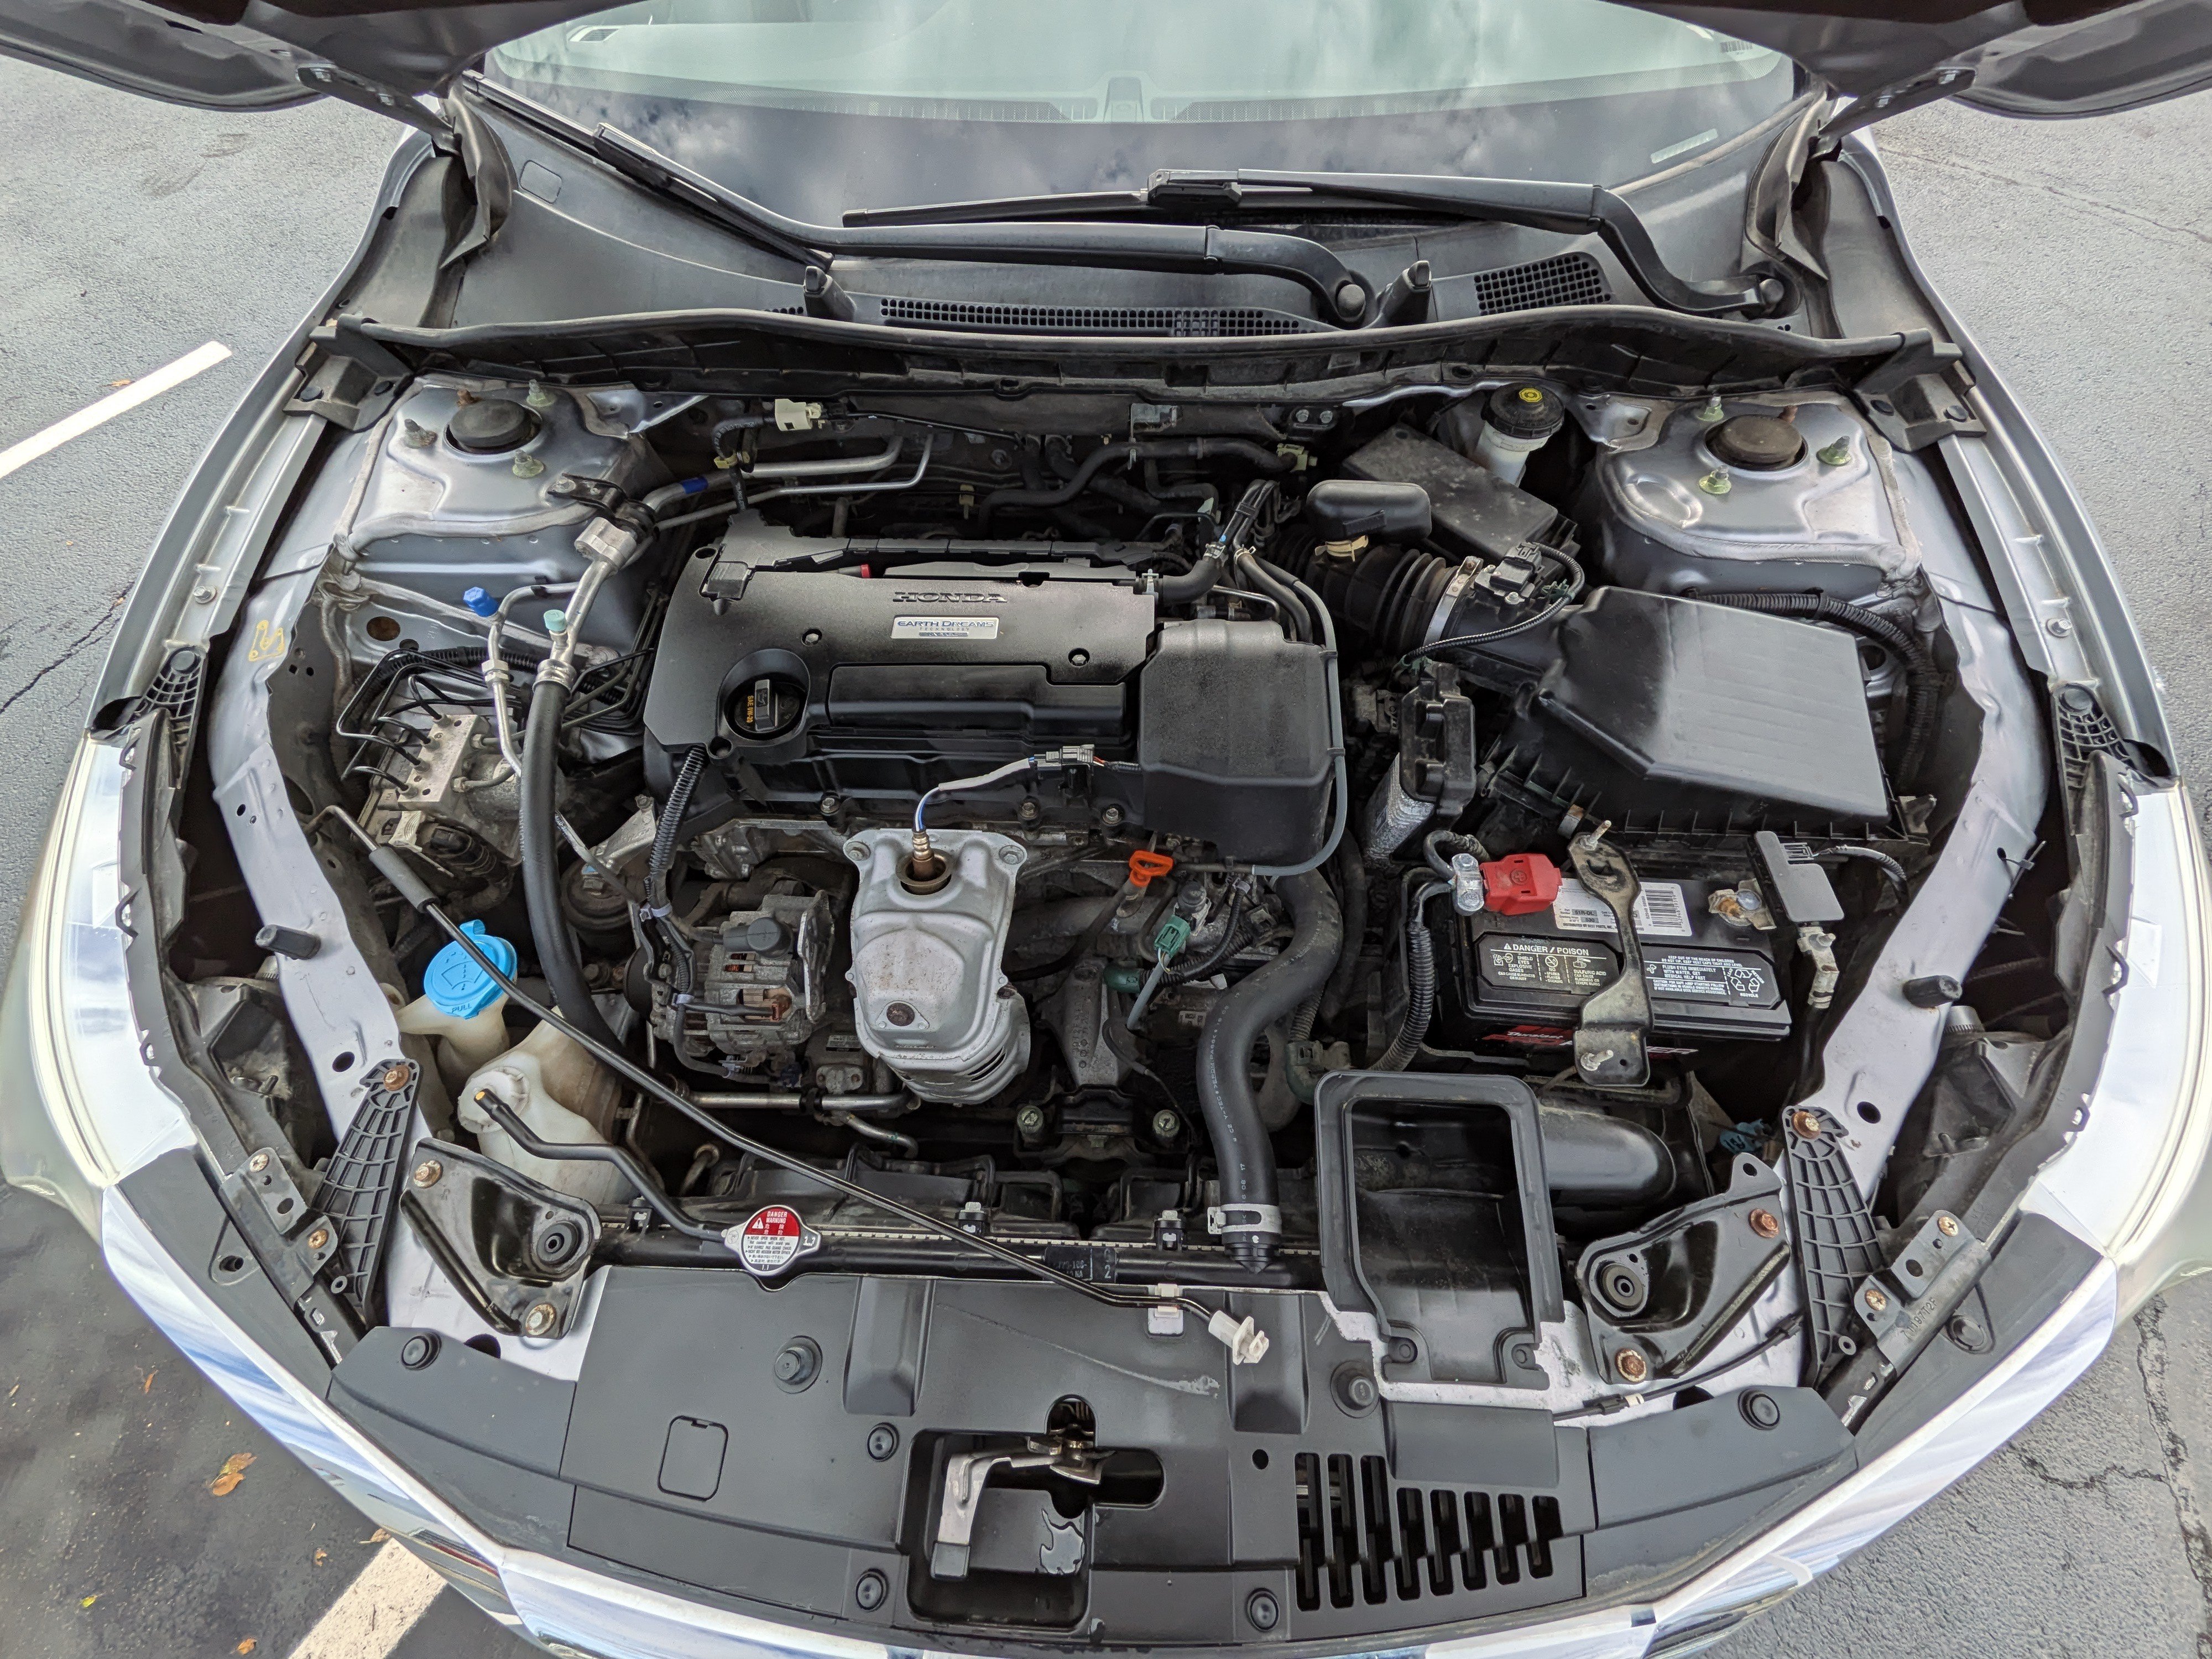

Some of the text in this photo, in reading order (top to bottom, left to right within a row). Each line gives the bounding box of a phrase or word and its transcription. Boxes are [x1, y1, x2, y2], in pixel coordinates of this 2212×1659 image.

[893, 592, 1008, 603] HONDA
[1512, 944, 1548, 953] DANGER
[1557, 947, 1589, 956] POISON
[452, 1004, 472, 1013] PULL
